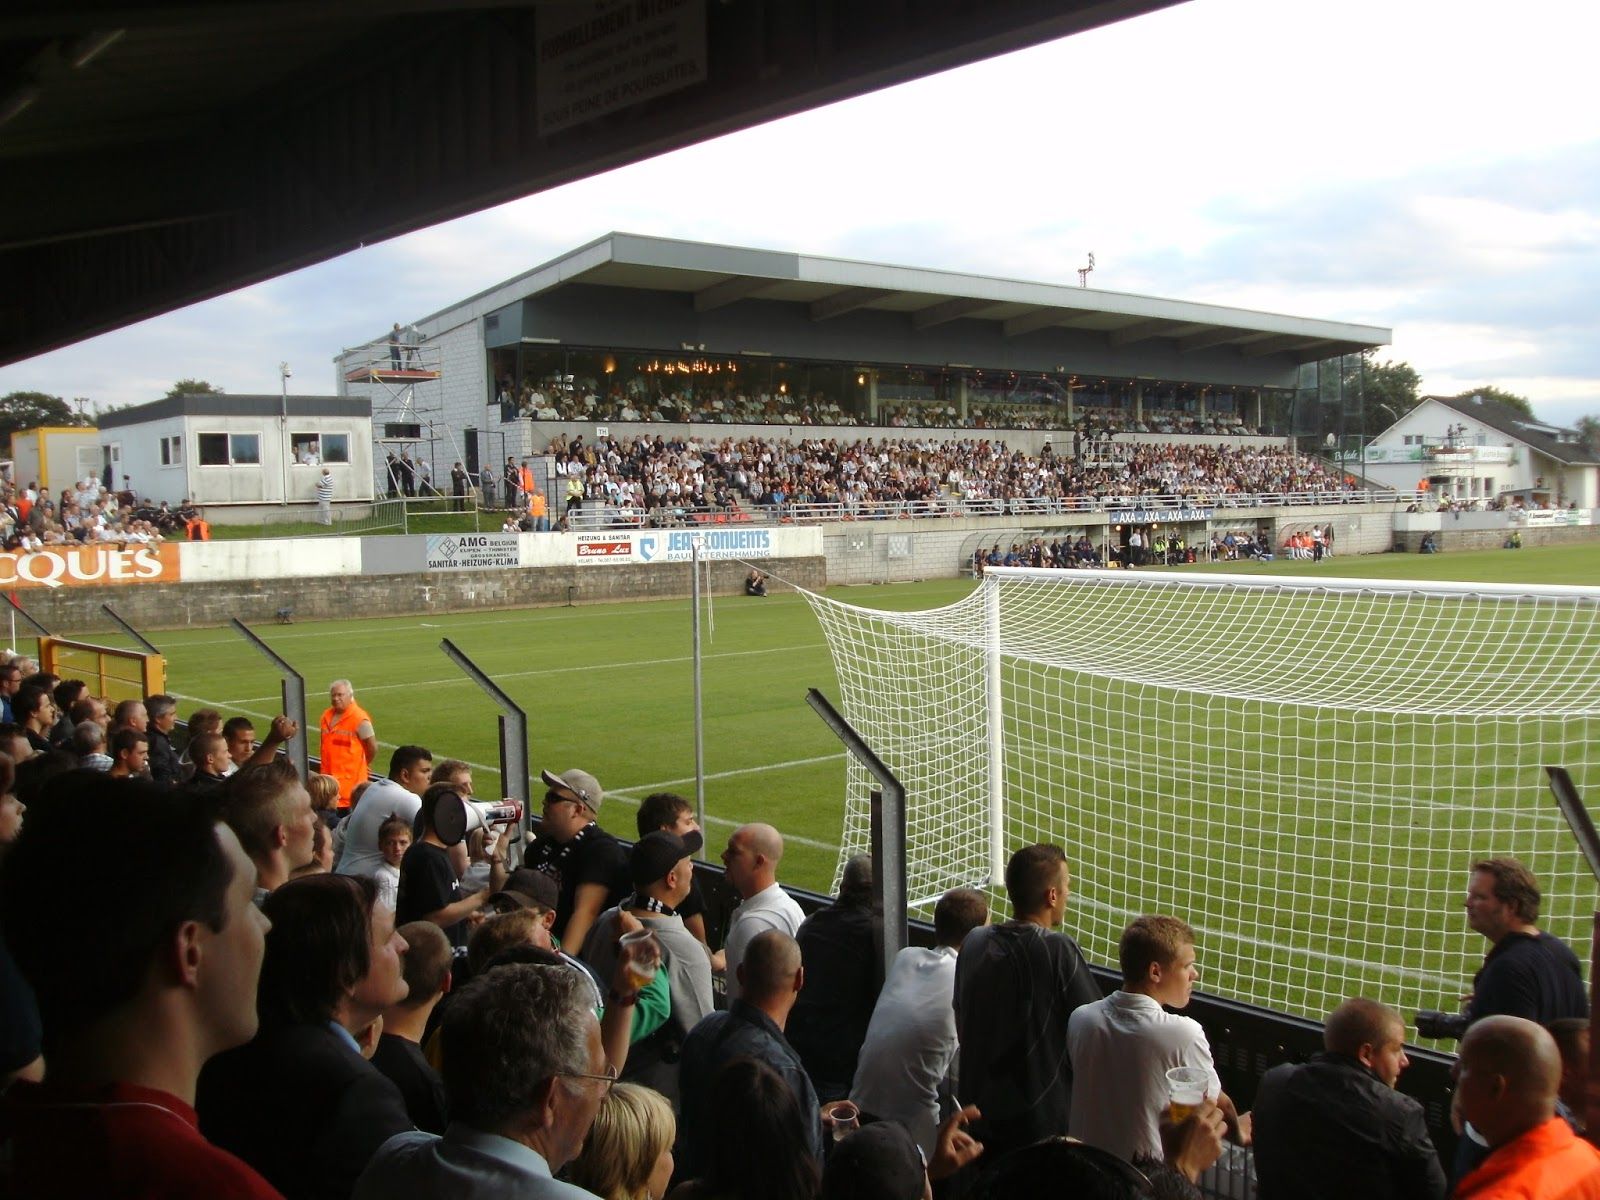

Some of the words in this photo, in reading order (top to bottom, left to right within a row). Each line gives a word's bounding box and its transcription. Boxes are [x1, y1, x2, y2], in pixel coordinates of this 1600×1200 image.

[1119, 512, 1136, 523] AXA
[1144, 511, 1160, 522] AXA
[1168, 510, 1183, 521] AXA
[1190, 509, 1206, 520] AXA
[459, 537, 487, 547] AMG
[668, 532, 700, 551] JEA
[579, 545, 607, 555] Bruno
[611, 544, 630, 554] Lux
